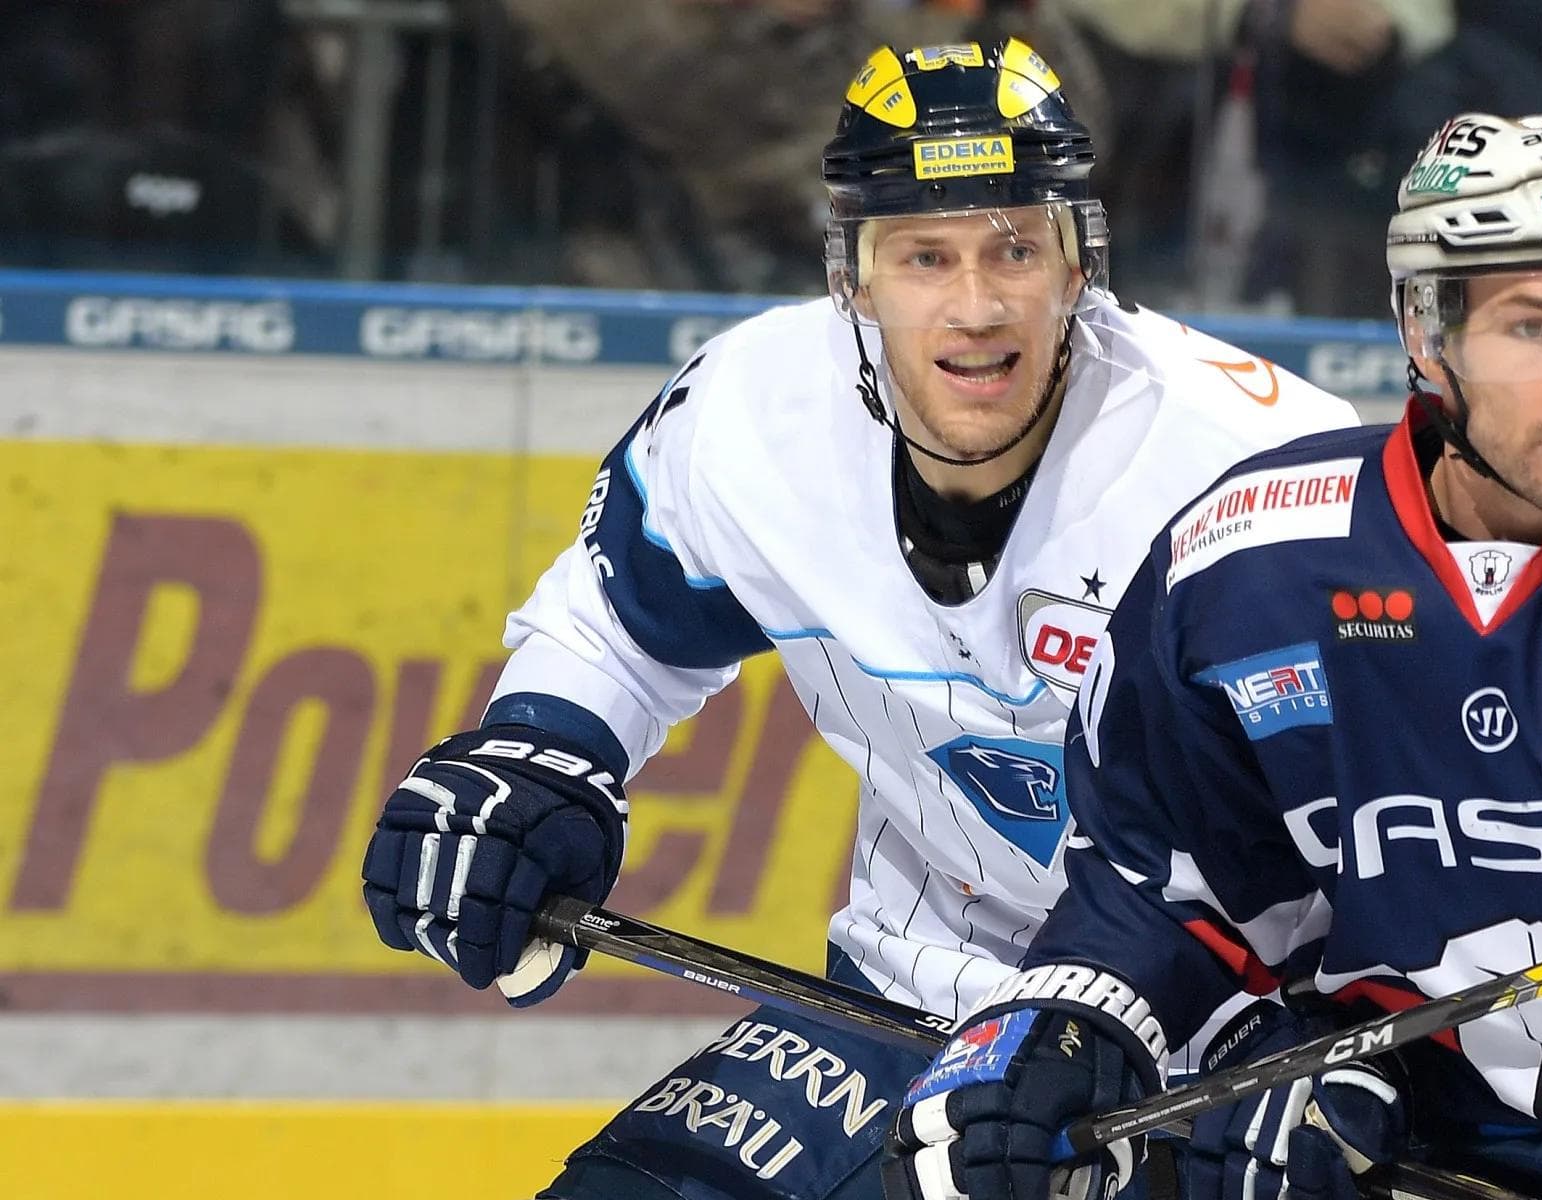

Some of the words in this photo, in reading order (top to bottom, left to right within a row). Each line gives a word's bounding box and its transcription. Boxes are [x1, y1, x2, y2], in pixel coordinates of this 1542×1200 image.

[920, 142, 1006, 162] EDEKA
[65, 298, 294, 351] GASAG
[360, 308, 598, 361] GASAG
[1216, 485, 1259, 524] VON
[1262, 474, 1355, 512] HEIDEN
[1188, 519, 1252, 556] VHÄUSER
[1031, 623, 1099, 676] DE
[1338, 621, 1414, 641] SECURITAS
[1248, 693, 1330, 724] STICS
[633, 1077, 804, 1181] BRÄU
